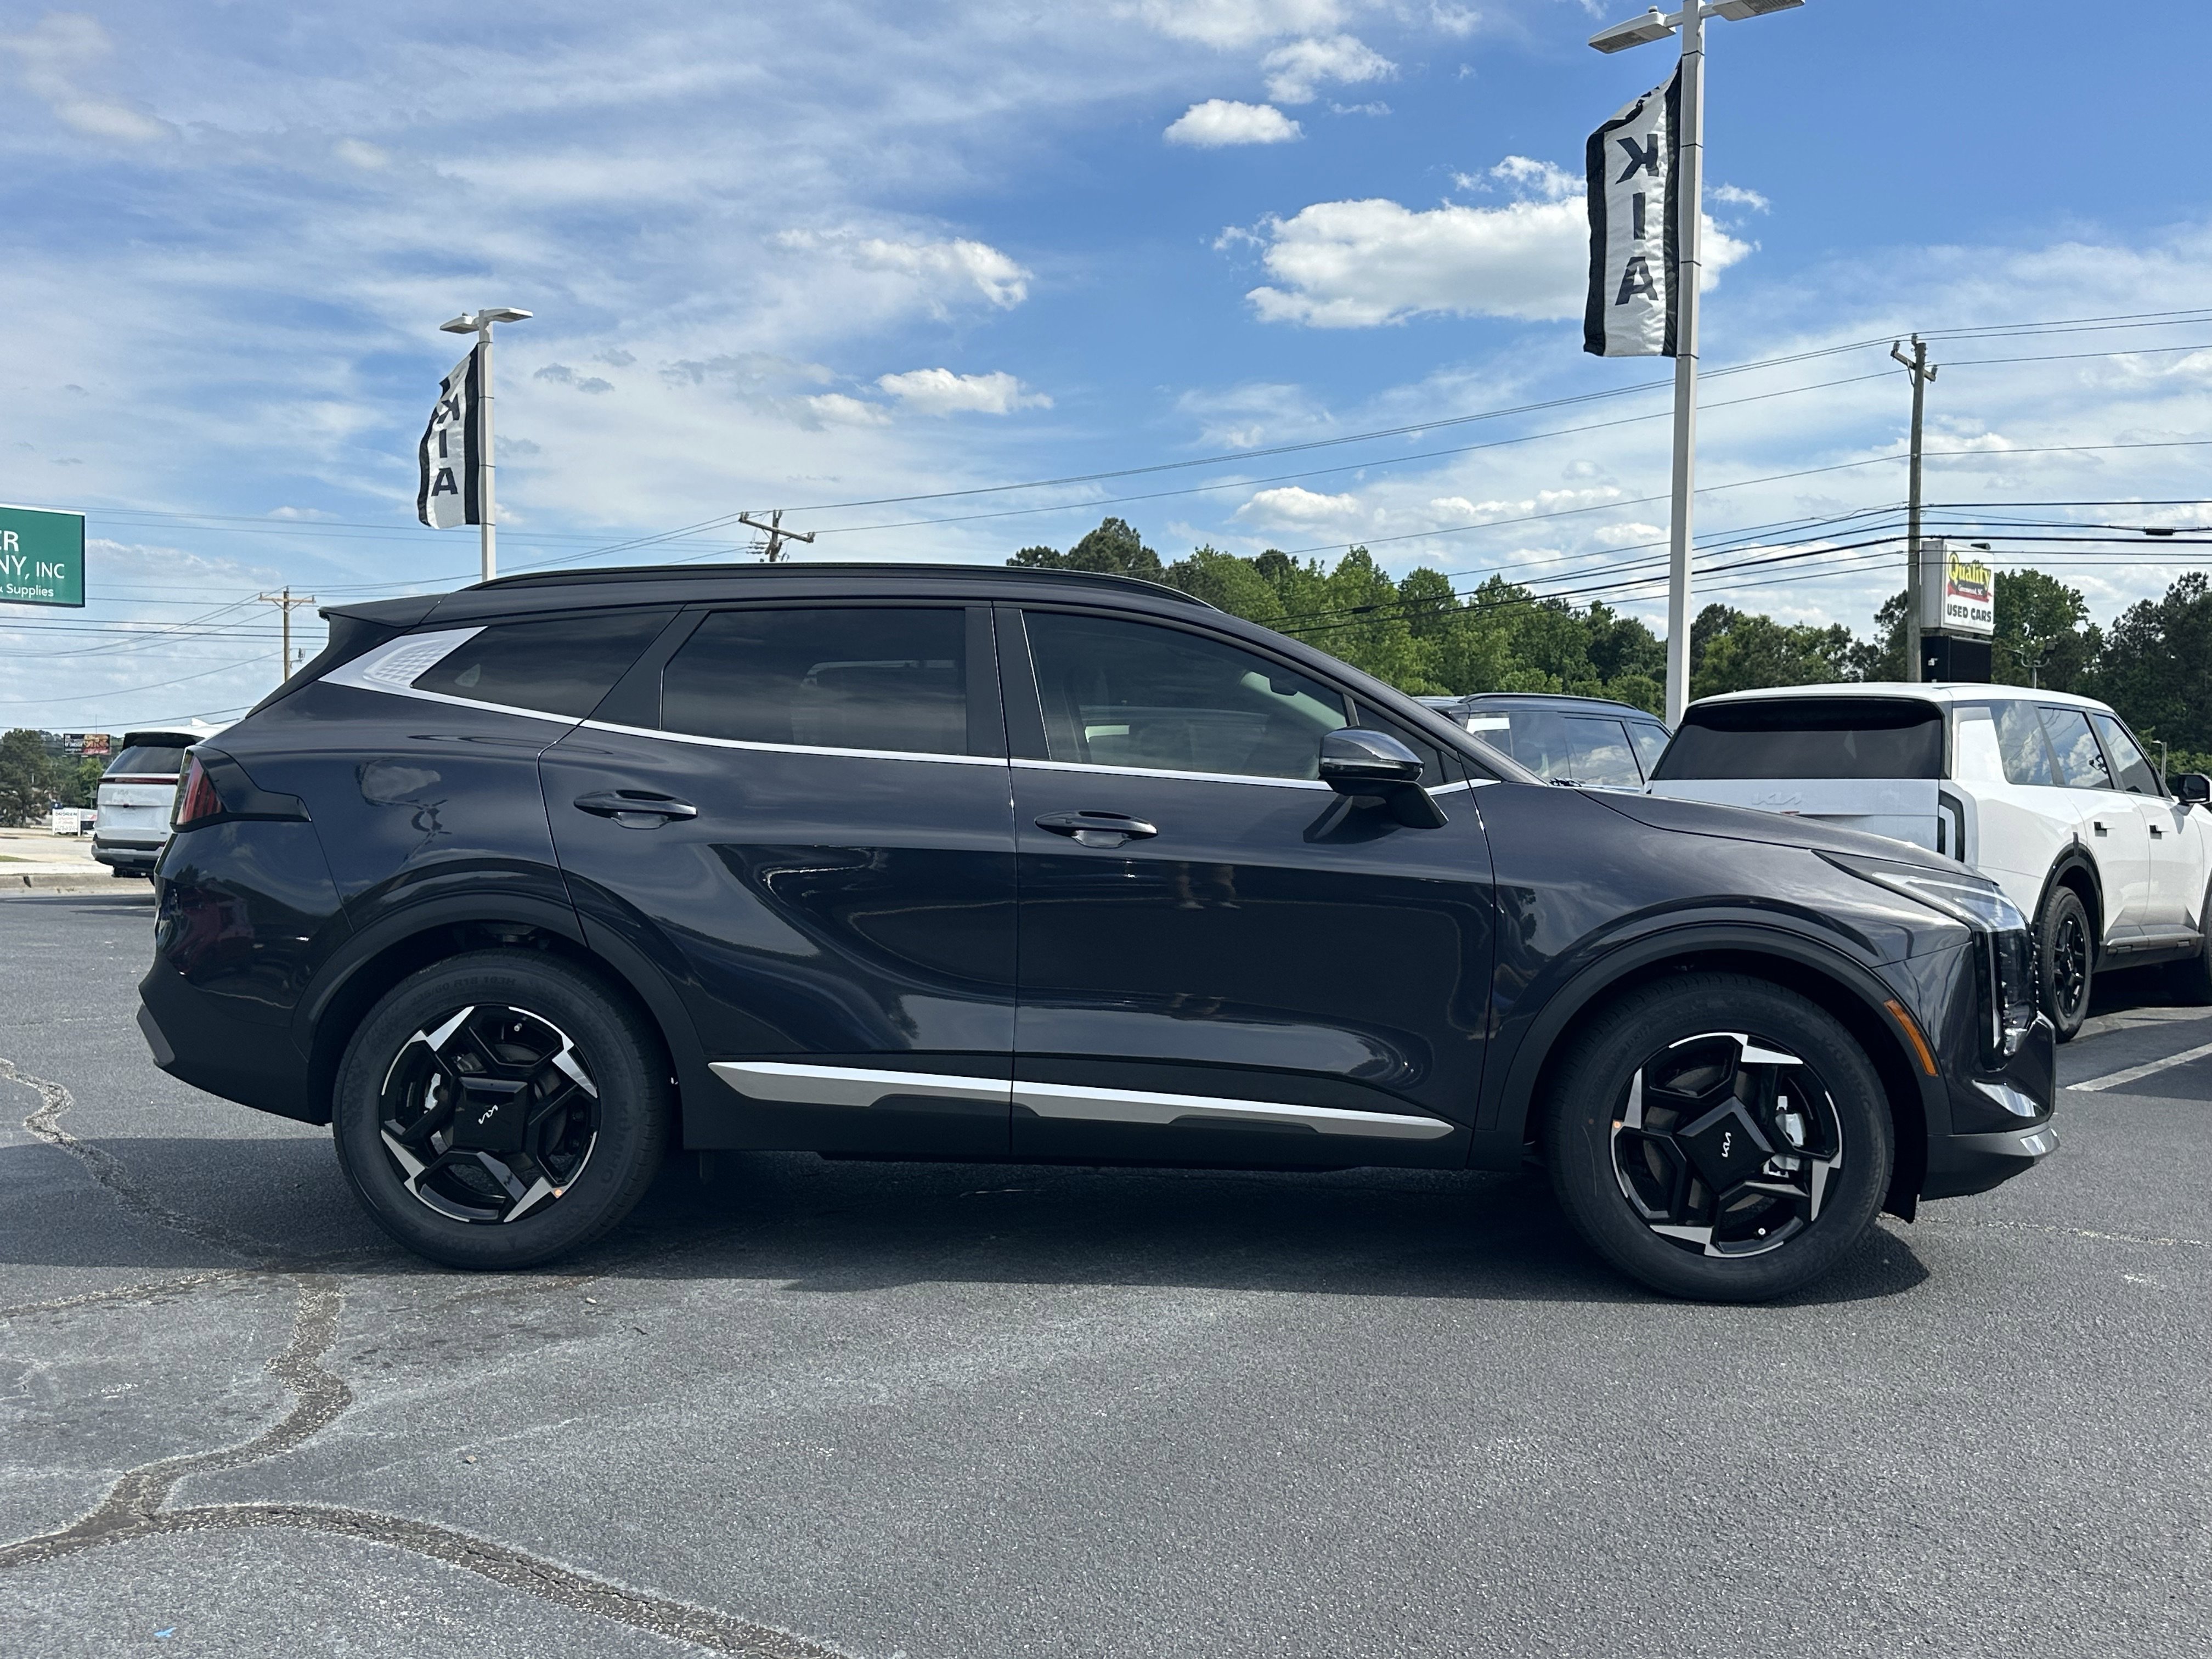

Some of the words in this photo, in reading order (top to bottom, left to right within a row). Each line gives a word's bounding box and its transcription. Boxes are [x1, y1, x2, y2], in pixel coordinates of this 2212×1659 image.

[0, 530, 19, 552] R
[36, 561, 65, 579] INC
[1948, 552, 1991, 591] Quality
[6, 583, 54, 599] Supplies
[1947, 603, 1968, 619] USED
[1971, 608, 1991, 623] CARS
